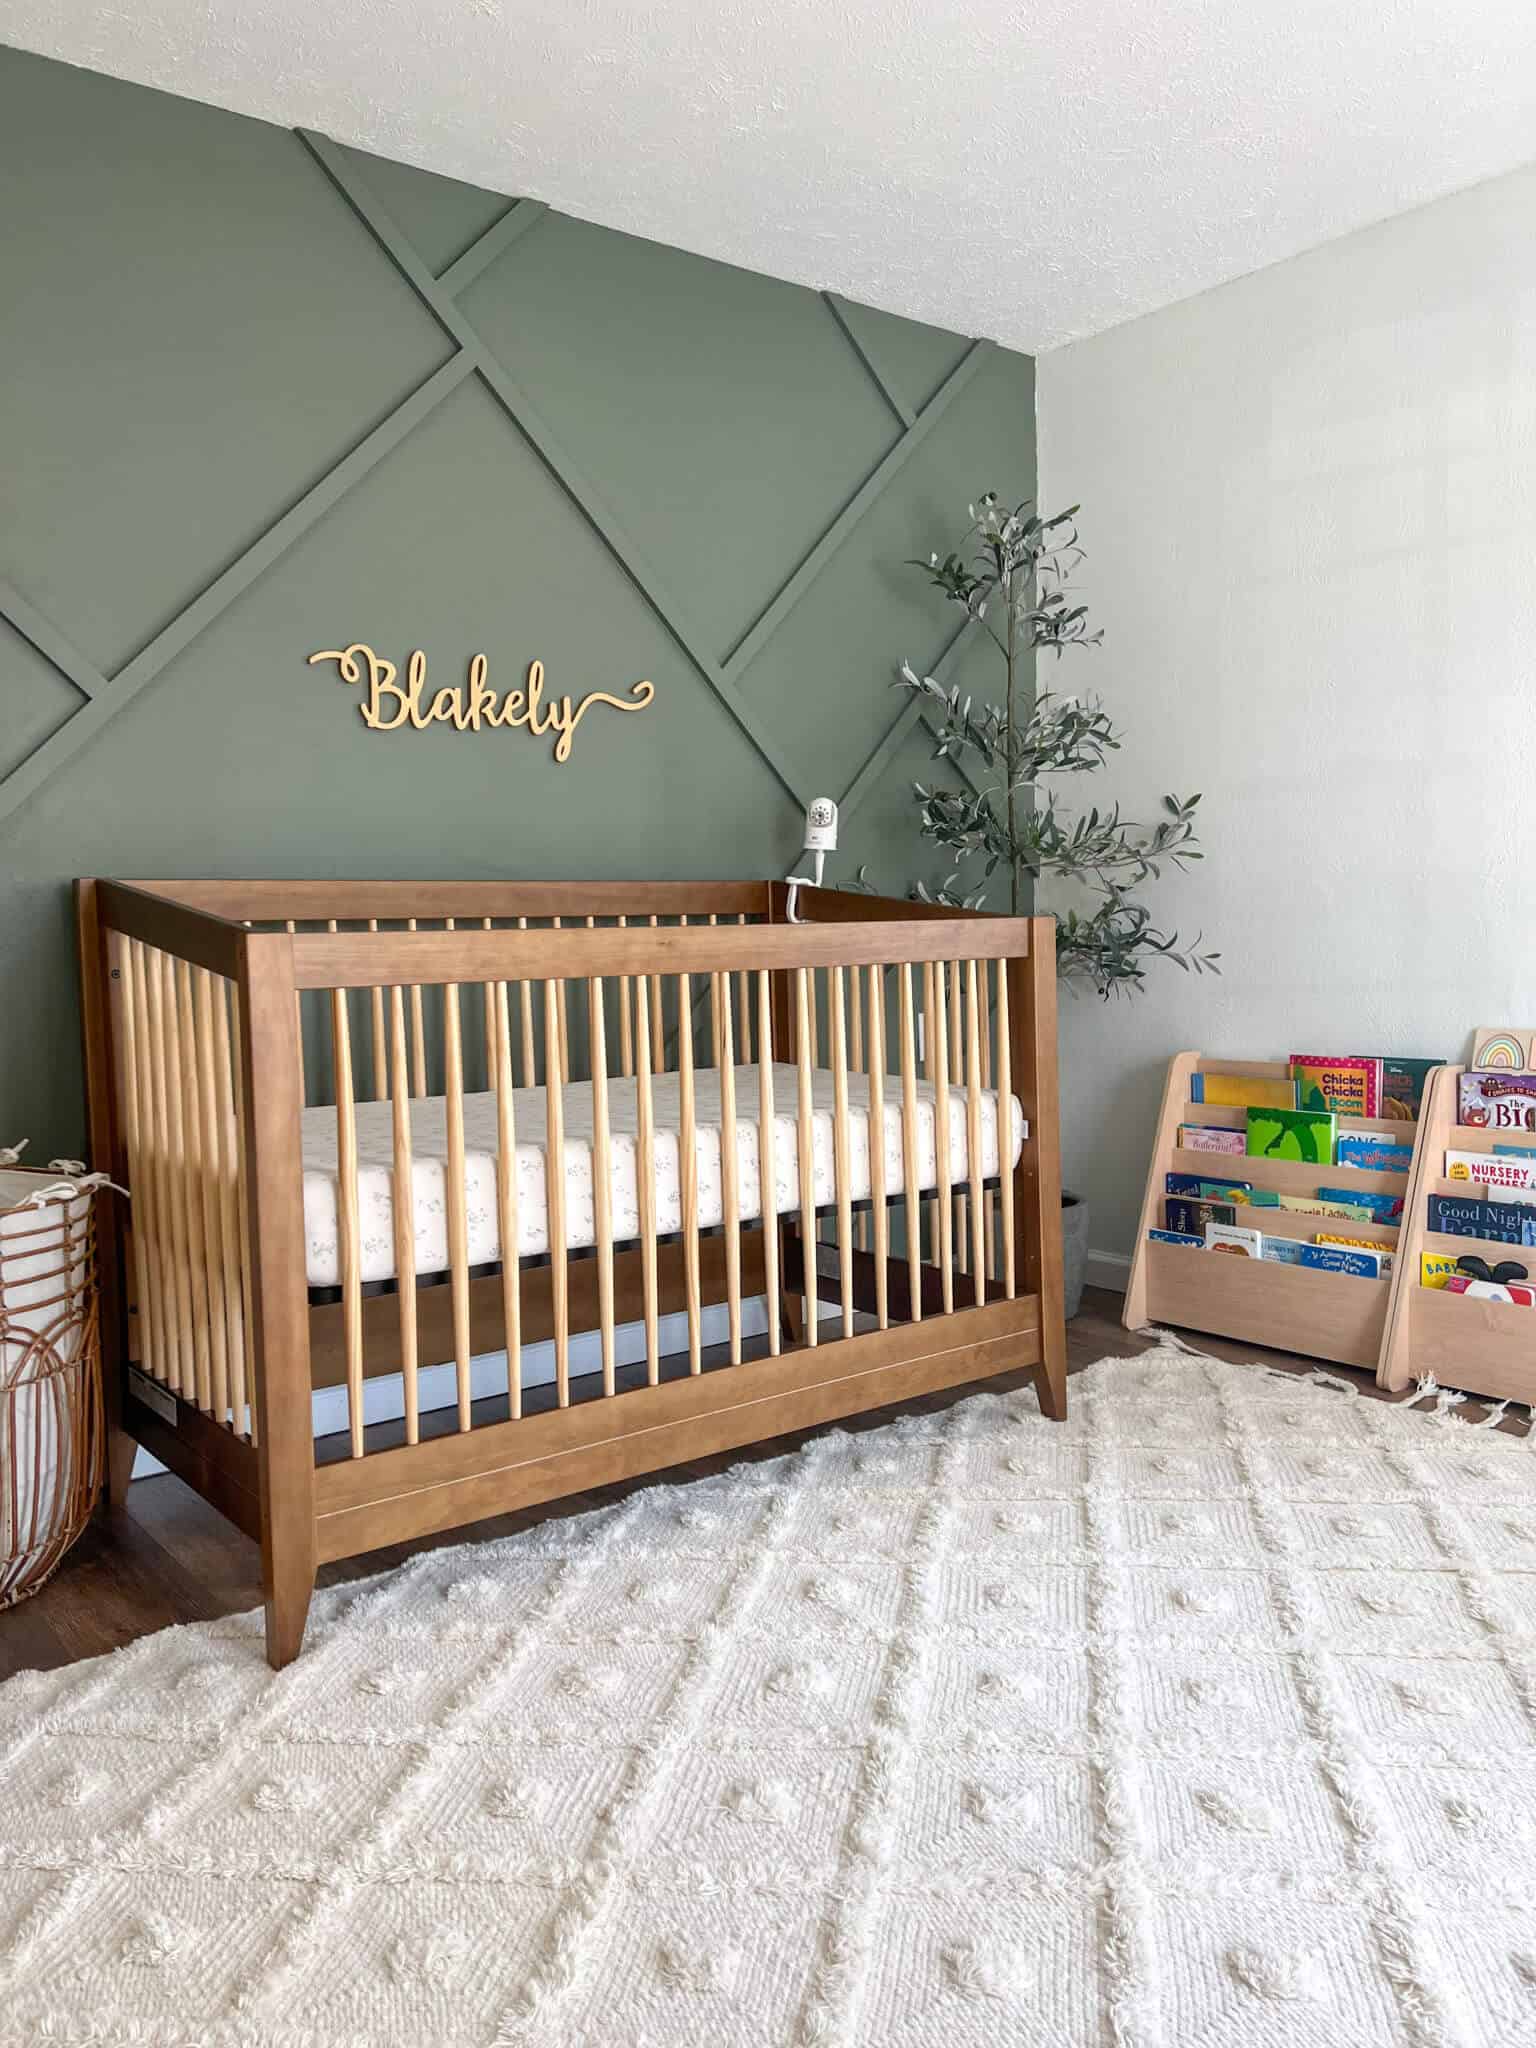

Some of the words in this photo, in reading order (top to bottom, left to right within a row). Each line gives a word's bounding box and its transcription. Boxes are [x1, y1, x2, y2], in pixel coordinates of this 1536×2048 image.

[307, 643, 655, 763] Blakely
[1322, 1073, 1363, 1086] Chicka
[1322, 1085, 1363, 1097] Chicka
[1329, 1097, 1362, 1108] Boom
[1510, 1099, 1525, 1108] The
[1472, 1164, 1528, 1180] NURSERY
[1438, 1201, 1480, 1220] Good
[1426, 1263, 1457, 1275] BABY
